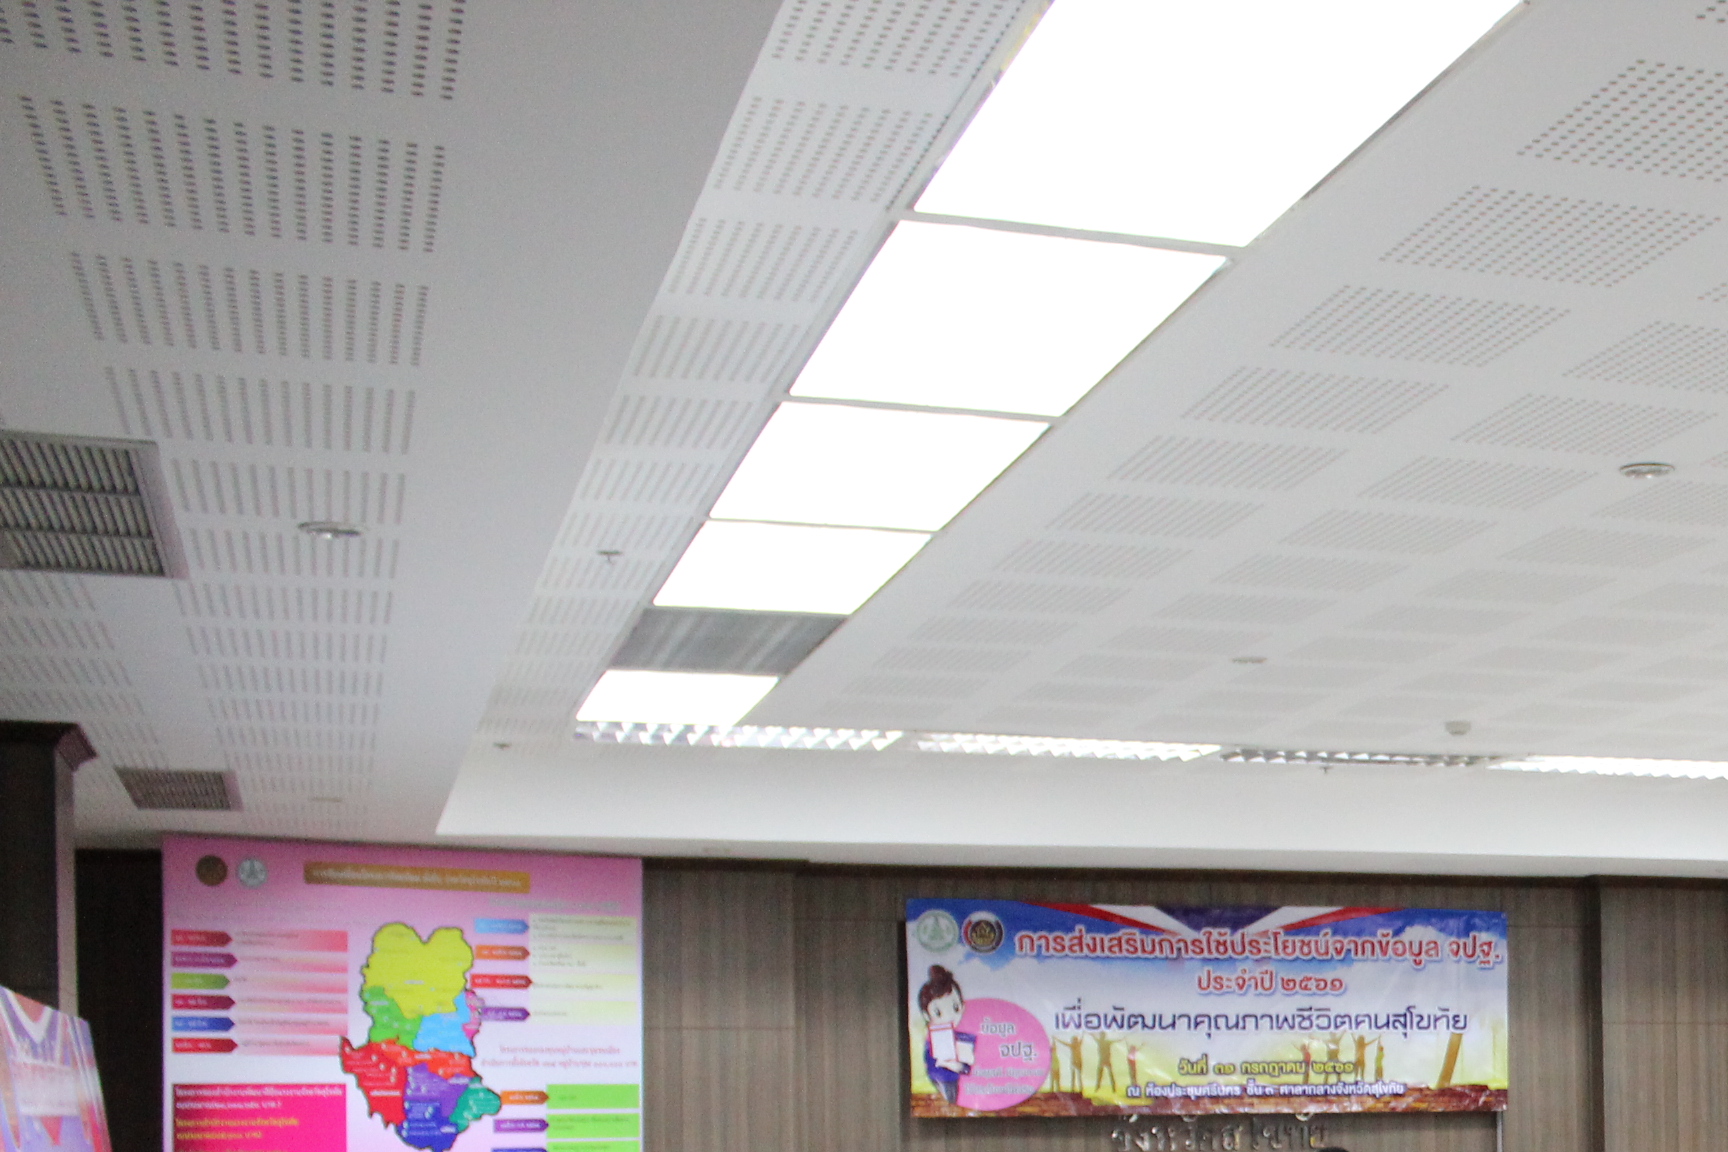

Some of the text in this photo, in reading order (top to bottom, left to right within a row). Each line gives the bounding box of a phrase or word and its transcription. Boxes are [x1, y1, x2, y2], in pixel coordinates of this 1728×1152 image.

[1015, 928, 1502, 967] การส่งเสริมการใช้ประโยชน์จากข้อมูล จปฐ.
[1197, 968, 1344, 994] ประจำปี ๒๕๖๑
[1054, 999, 1468, 1038] เพื่อพัฒนาคุณภาพชีวิตคนสุโขทัย
[1178, 1053, 1208, 1075] วันที่
[1241, 1063, 1306, 1078] กรกฎาคม
